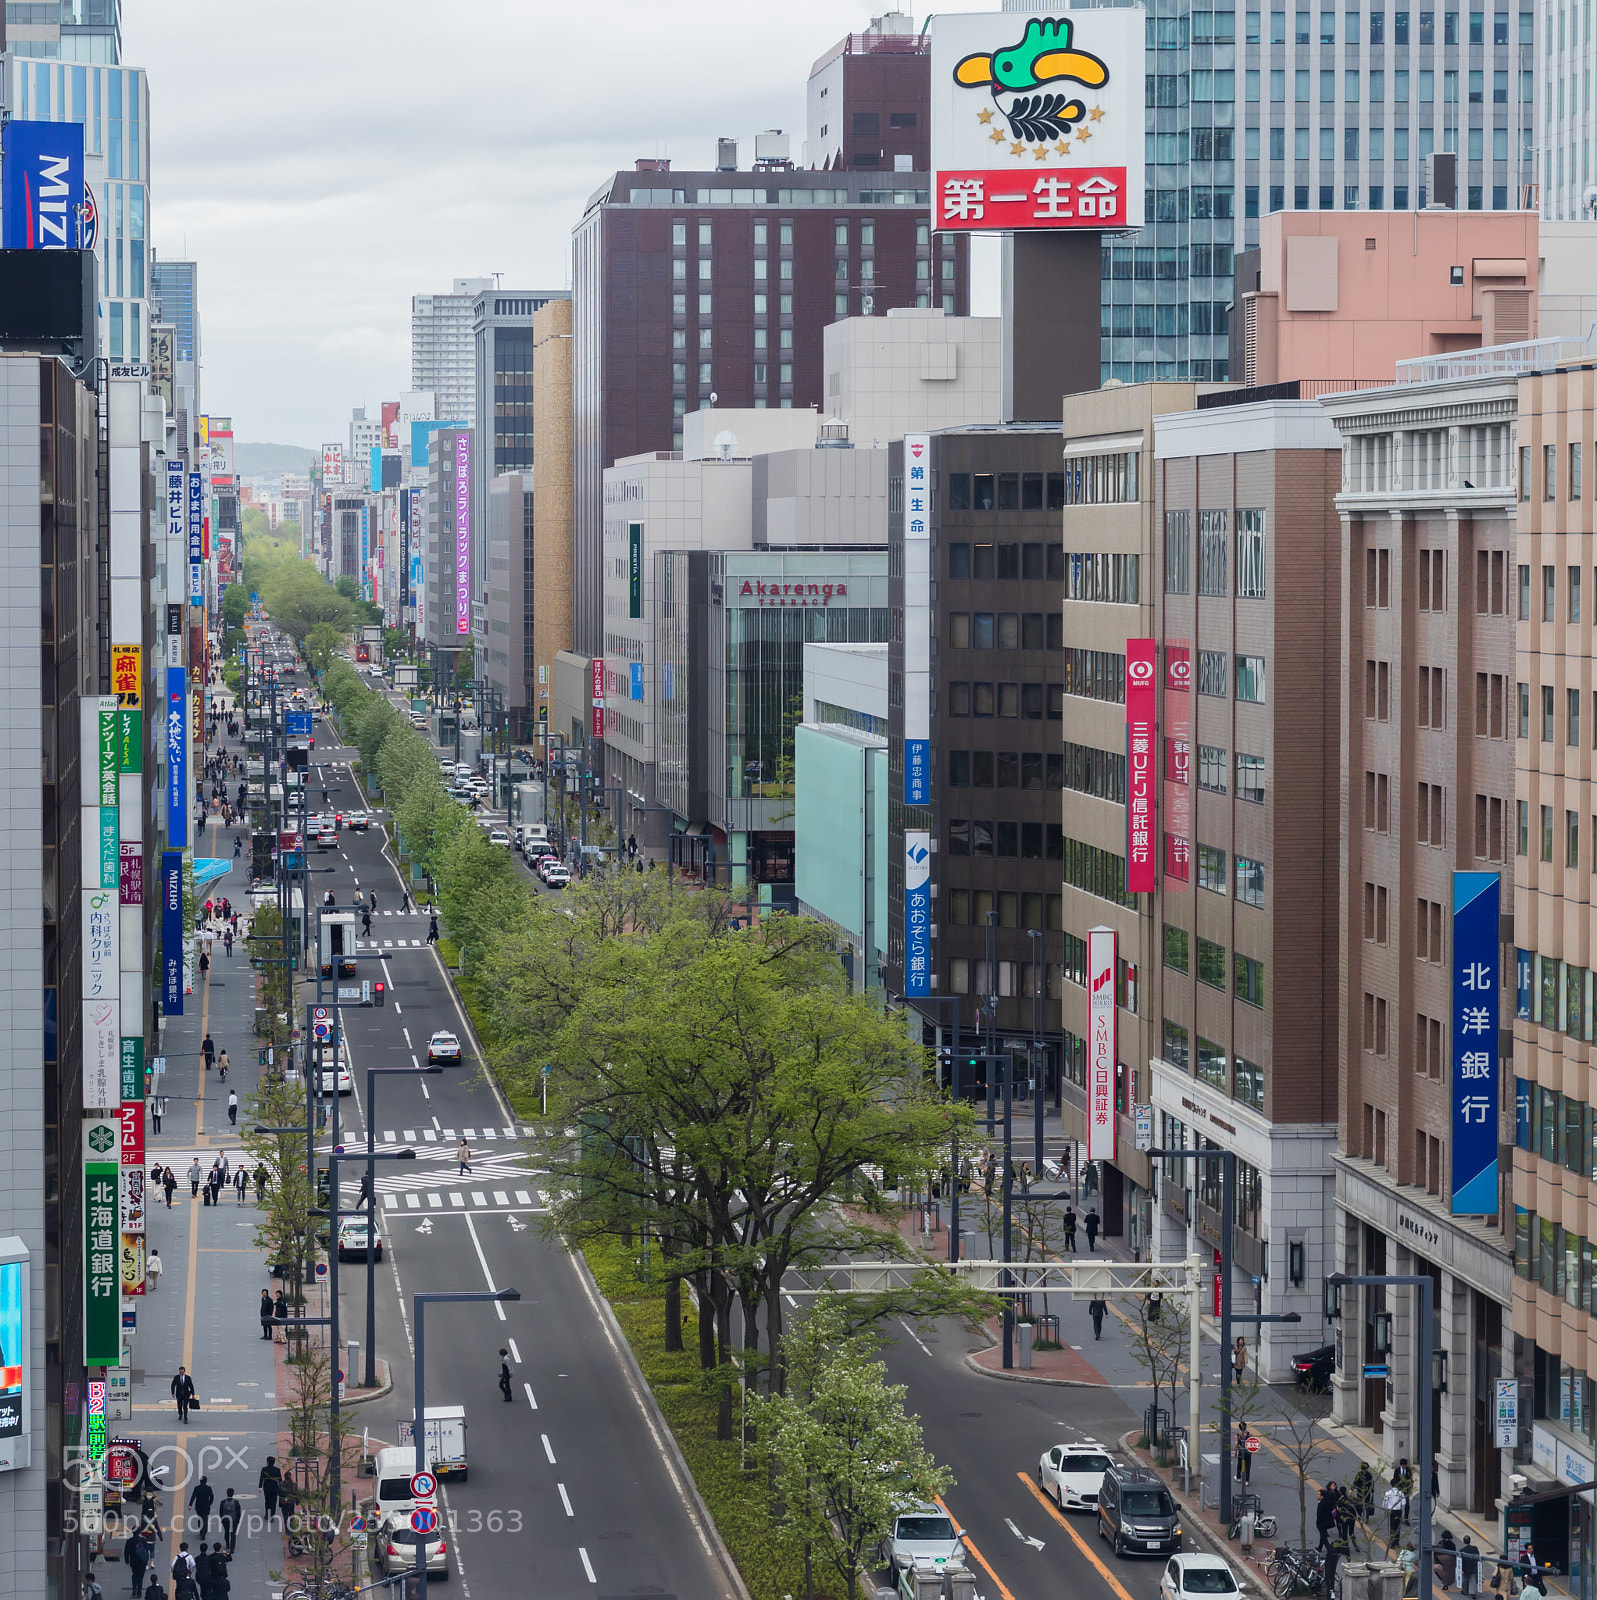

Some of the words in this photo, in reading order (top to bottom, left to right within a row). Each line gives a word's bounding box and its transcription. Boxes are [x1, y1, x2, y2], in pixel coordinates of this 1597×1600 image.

[943, 176, 1118, 220] 第一生命
[111, 367, 149, 377] 成友ビル
[168, 475, 182, 534] 藤井ビル
[190, 477, 201, 558] おしま信用金庫
[458, 437, 468, 615] さっぽろライラックまつり
[911, 466, 924, 532] 第一生命
[740, 580, 847, 598] Akarenga
[115, 655, 137, 691] 麻雀
[102, 712, 116, 805] マンツーマン英会話
[169, 711, 183, 763] 大地みらい
[911, 743, 922, 801] 伊藤忠商事
[1132, 721, 1149, 863] 三菱UFJ信託銀行
[103, 825, 115, 884] まえだ歯科
[121, 845, 135, 855] 5F
[131, 858, 142, 902] 札幌駅南
[169, 869, 178, 911] MIZUHO
[90, 911, 103, 996] 内科クリニック
[910, 893, 926, 987] あおぞら銀行
[168, 959, 178, 1003] みずほ銀行
[1095, 1014, 1108, 1126] SMBC日興証券
[1461, 962, 1491, 1124] 北洋銀行
[122, 1108, 136, 1146] アコム
[122, 1154, 136, 1163] 2F
[91, 1181, 114, 1297] 北海道銀行
[1504, 1434, 1510, 1442] 3
